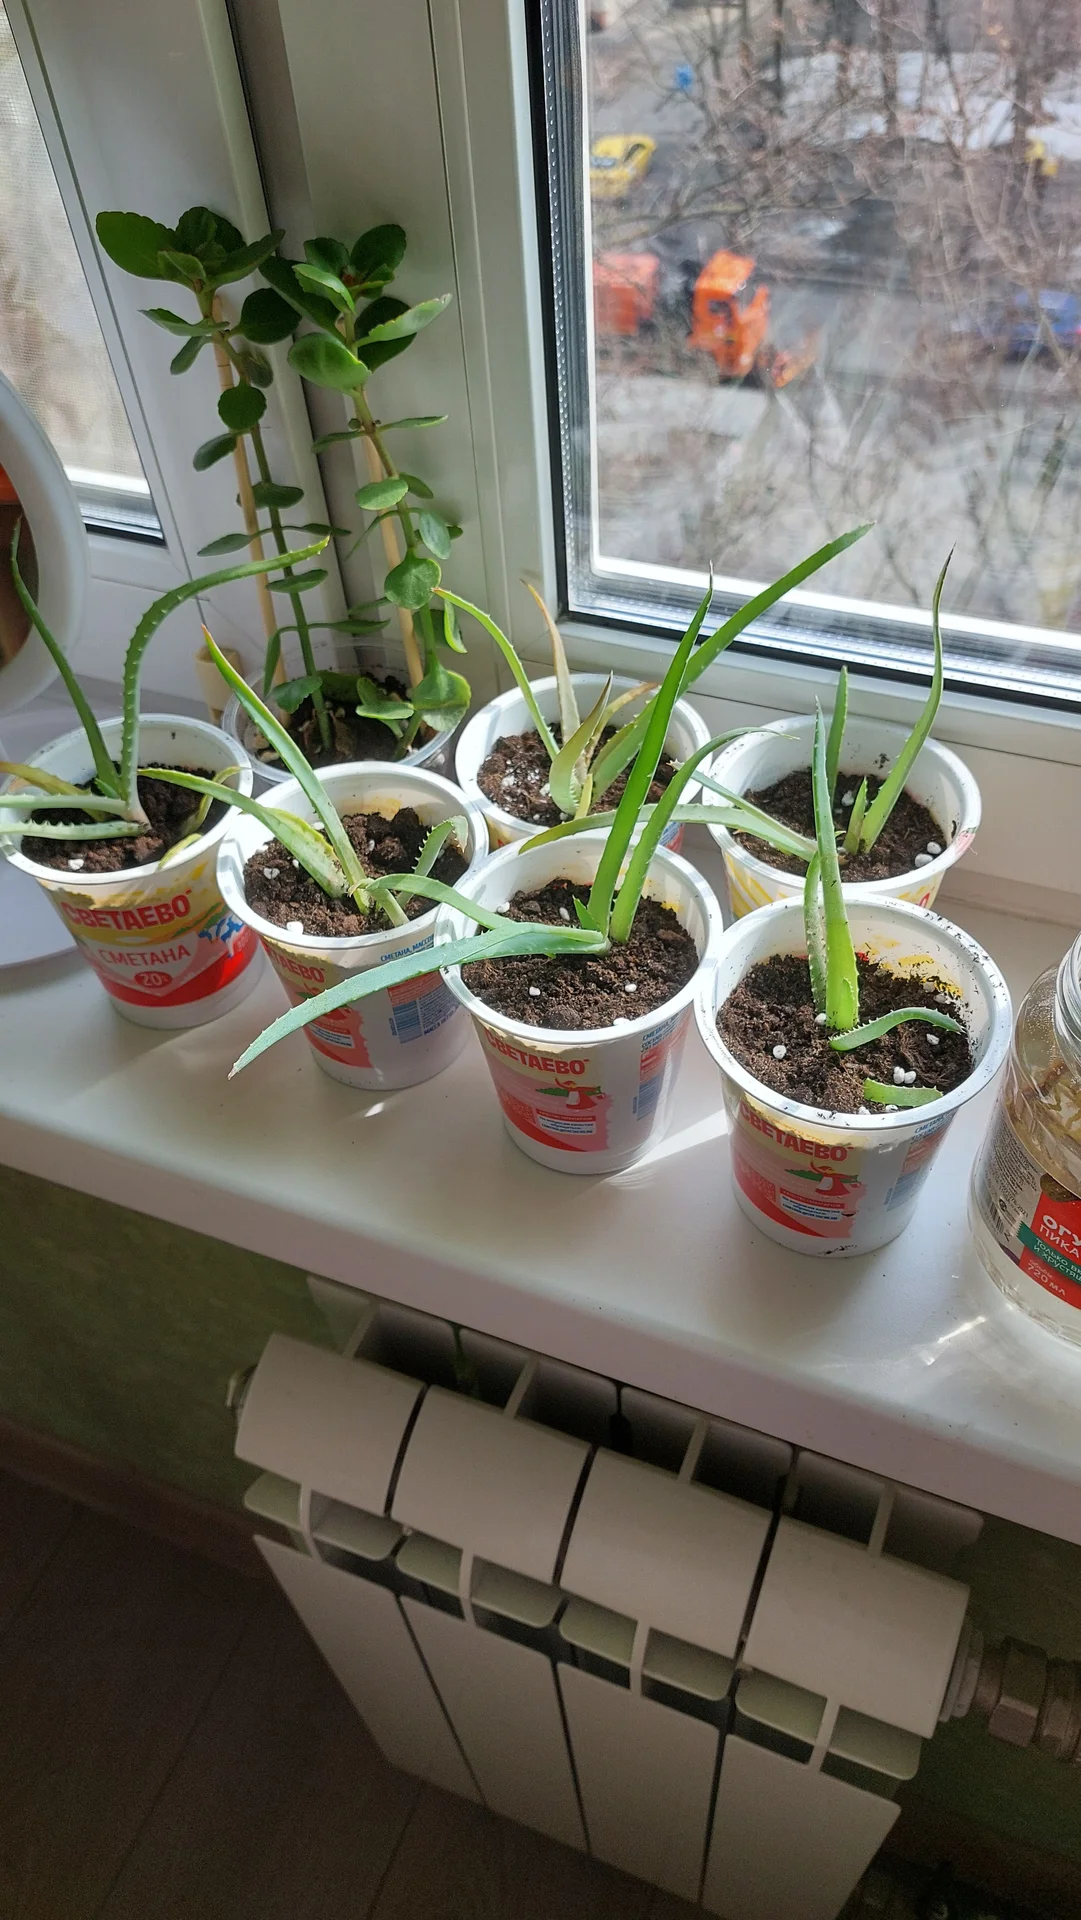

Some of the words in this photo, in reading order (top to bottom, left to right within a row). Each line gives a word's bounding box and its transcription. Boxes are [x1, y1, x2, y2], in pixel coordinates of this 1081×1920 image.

[61, 894, 191, 931] СВЕТАЕВО
[99, 944, 192, 967] СМЕТАНА
[484, 1028, 586, 1075] СВЕТАЕВО
[739, 1101, 848, 1162] СВЕТАЕВО
[1039, 1223, 1080, 1259] ПИКА
[1027, 1263, 1049, 1284] 720
